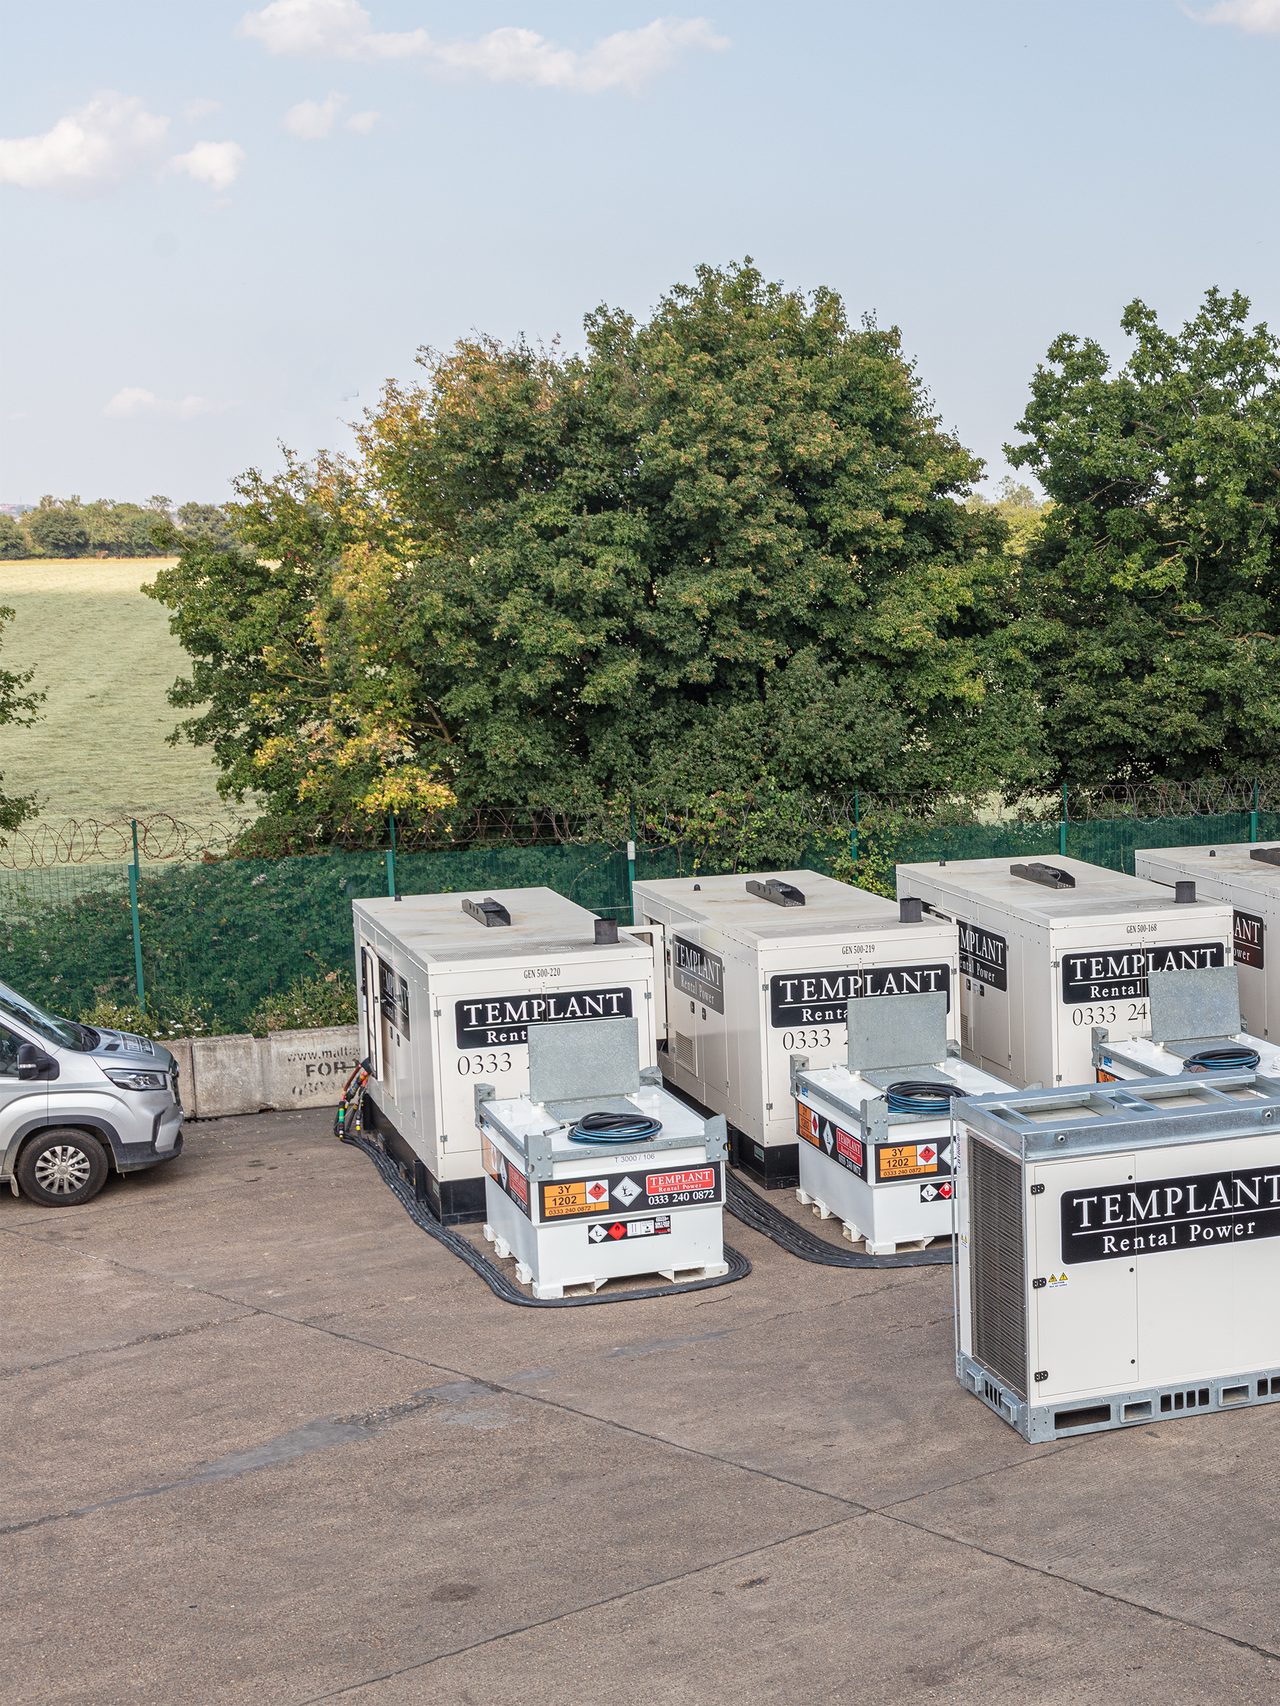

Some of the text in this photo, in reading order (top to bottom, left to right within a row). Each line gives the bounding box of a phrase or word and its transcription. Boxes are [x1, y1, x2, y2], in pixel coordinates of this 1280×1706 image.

[1126, 923, 1158, 934] GEN 500-168
[841, 944, 876, 955] GEN 500-219
[960, 927, 1004, 965] MPLANT
[674, 941, 721, 986] TEMPLANT
[1069, 947, 1217, 980] TEMPLANT
[523, 967, 561, 979] GEN 500-220
[976, 963, 995, 983] Power
[779, 969, 942, 1002] TEMPLANT
[1090, 981, 1141, 999] Rental
[463, 992, 624, 1026] TEMPLANT
[801, 1008, 848, 1022] Renta
[1072, 1003, 1150, 1027] 0333 24
[486, 1029, 527, 1044] Rent
[782, 1028, 831, 1051] 0333
[305, 1061, 347, 1077] FOR
[457, 1052, 512, 1076] 0333
[620, 1155, 638, 1163] 3000
[643, 1153, 656, 1161] 106
[891, 1147, 904, 1157] 3Y
[886, 1157, 909, 1168] 1202
[650, 1170, 711, 1186] TEMPLANT
[557, 1184, 572, 1195] 3Y
[658, 1182, 702, 1193] Rental Power
[552, 1195, 577, 1207] 1202
[648, 1189, 715, 1206] 0333 240 0872
[548, 1205, 591, 1216] 0333 240 0872
[1103, 1220, 1256, 1254] Rental Power
